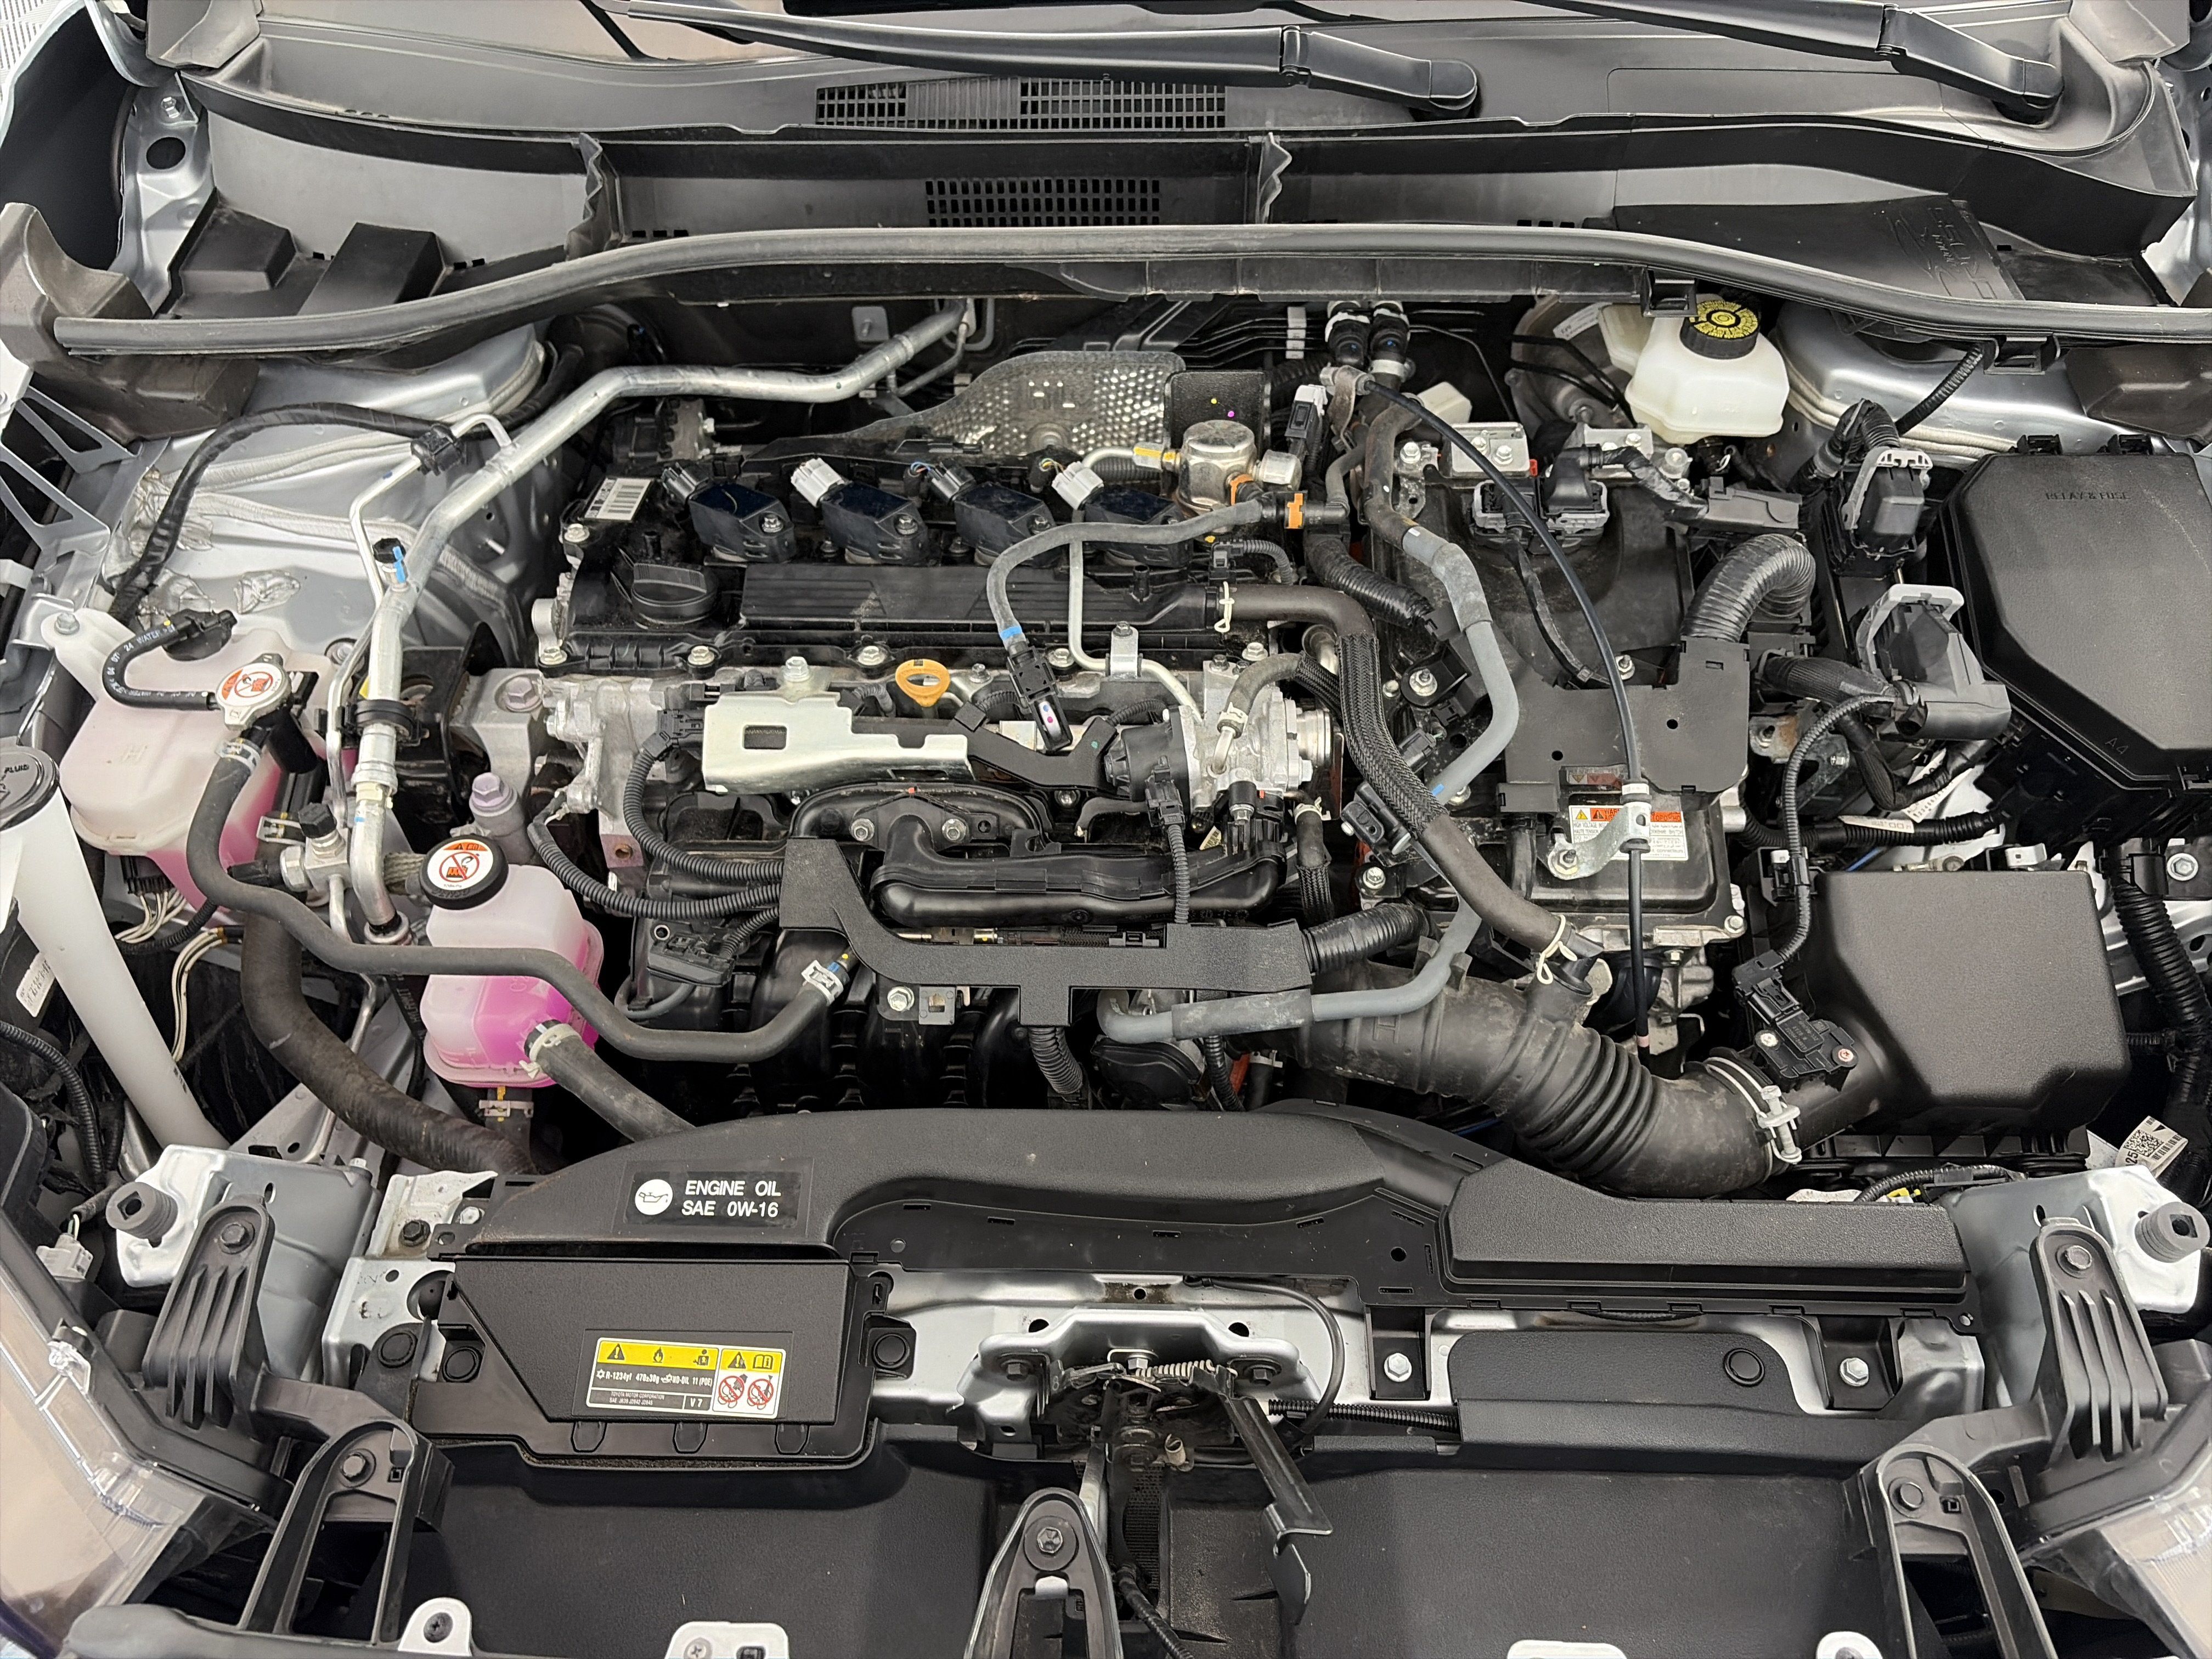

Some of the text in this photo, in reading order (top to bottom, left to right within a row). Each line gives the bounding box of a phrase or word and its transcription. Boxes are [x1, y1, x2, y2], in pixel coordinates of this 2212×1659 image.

[685, 1180, 782, 1197] ENGINE OIL
[681, 1200, 778, 1217] SAE 0W-16
[606, 1371, 632, 1382] R-1234yf
[699, 1377, 713, 1387] (POE)
[690, 1398, 703, 1407] V 7
